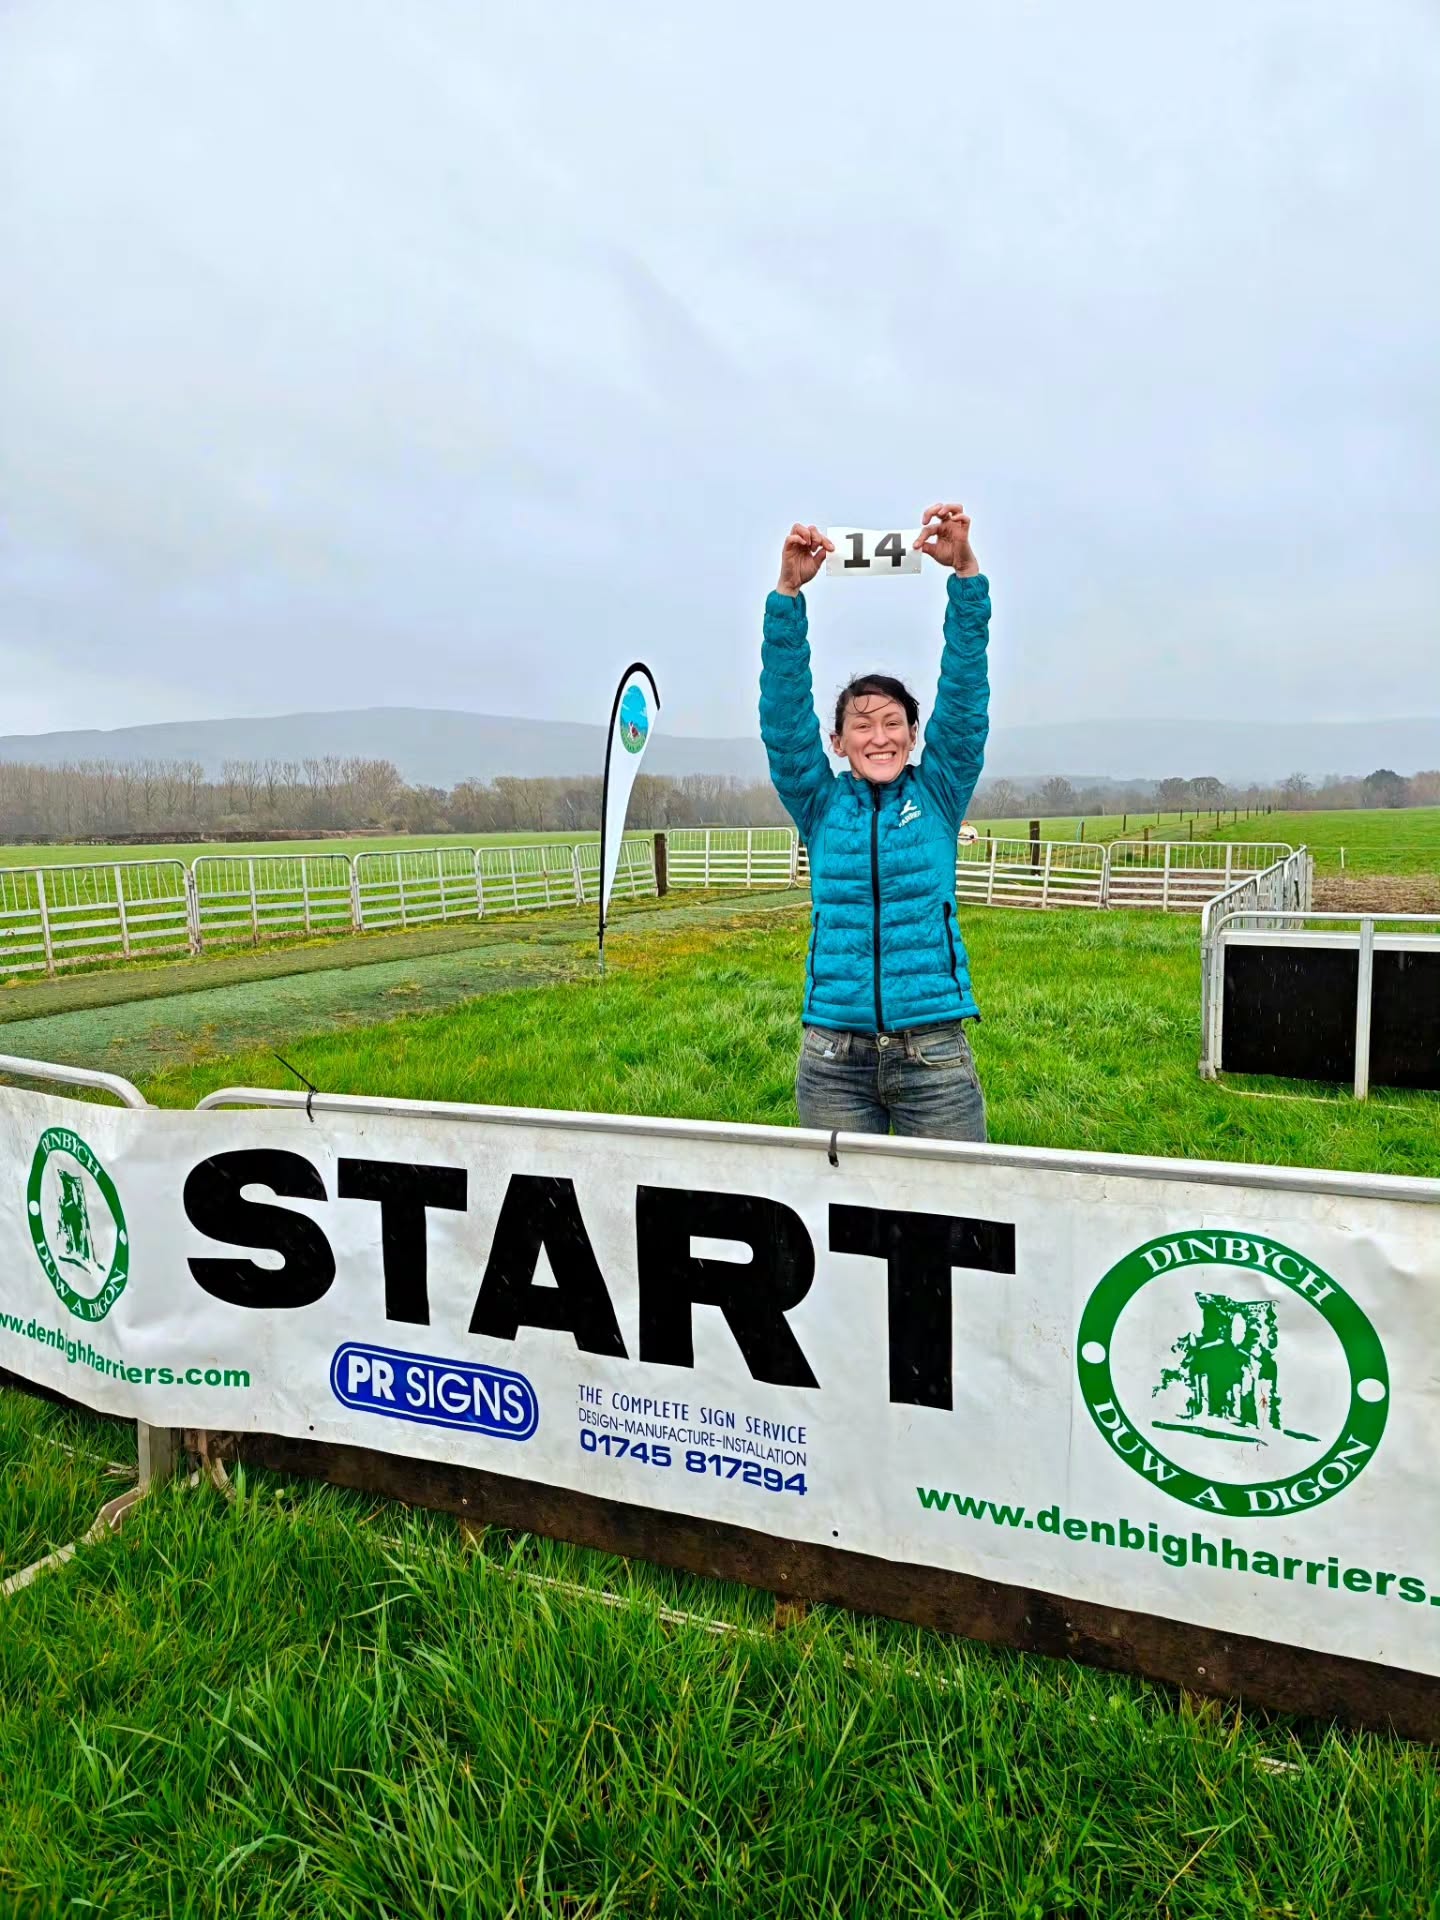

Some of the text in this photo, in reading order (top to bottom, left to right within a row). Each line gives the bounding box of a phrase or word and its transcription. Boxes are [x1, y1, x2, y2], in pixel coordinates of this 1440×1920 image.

[844, 533, 906, 568] 14
[36, 1241, 127, 1319] DUW A DIGON
[184, 1148, 1016, 1411] START
[1140, 1236, 1337, 1306] DINBYCH
[348, 1355, 525, 1425] PR SIGNS
[578, 1384, 807, 1445] THE COMPLETE SIGN SERVICE
[578, 1407, 807, 1467] DESIGN-MANUFACTURE-INSTALLATION
[580, 1429, 808, 1496] 01745 817294
[1092, 1398, 1372, 1512] DUW A DIGON
